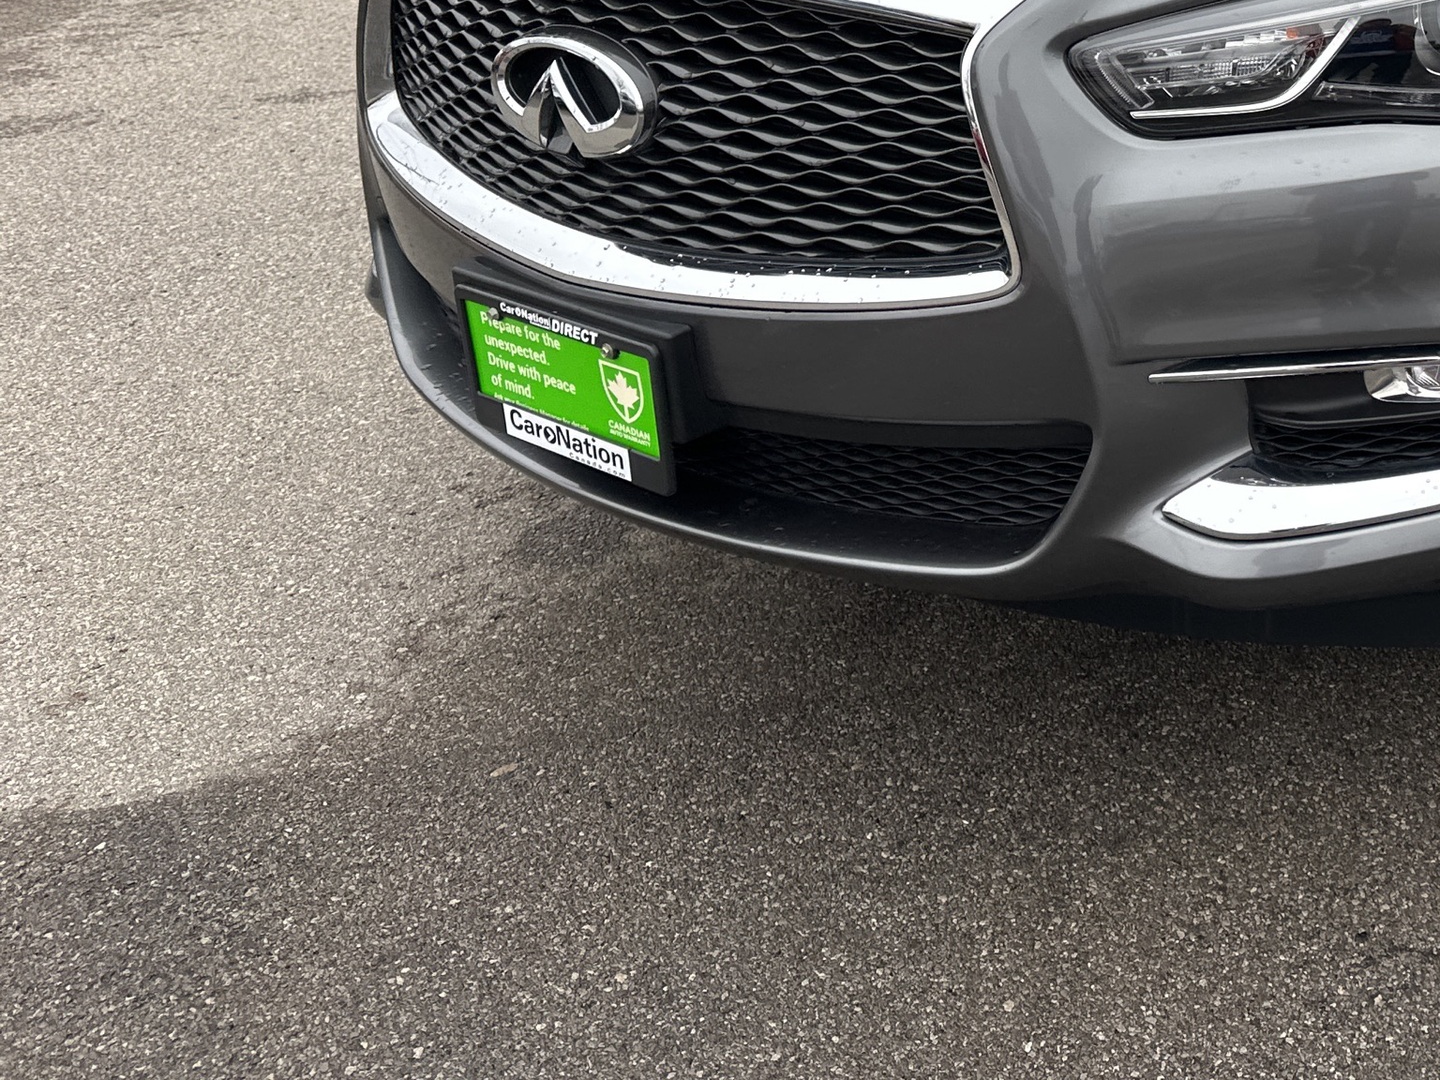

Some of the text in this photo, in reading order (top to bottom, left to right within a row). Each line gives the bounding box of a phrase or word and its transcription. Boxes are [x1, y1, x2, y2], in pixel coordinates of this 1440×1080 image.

[480, 311, 522, 337] Prepare
[524, 325, 540, 343] for
[542, 332, 561, 350] the
[551, 318, 598, 345] DIRECT
[484, 334, 550, 366] unexpected.
[487, 351, 577, 395] Drive with peace
[491, 374, 535, 400] of mind.
[608, 419, 651, 442] CANADIAN
